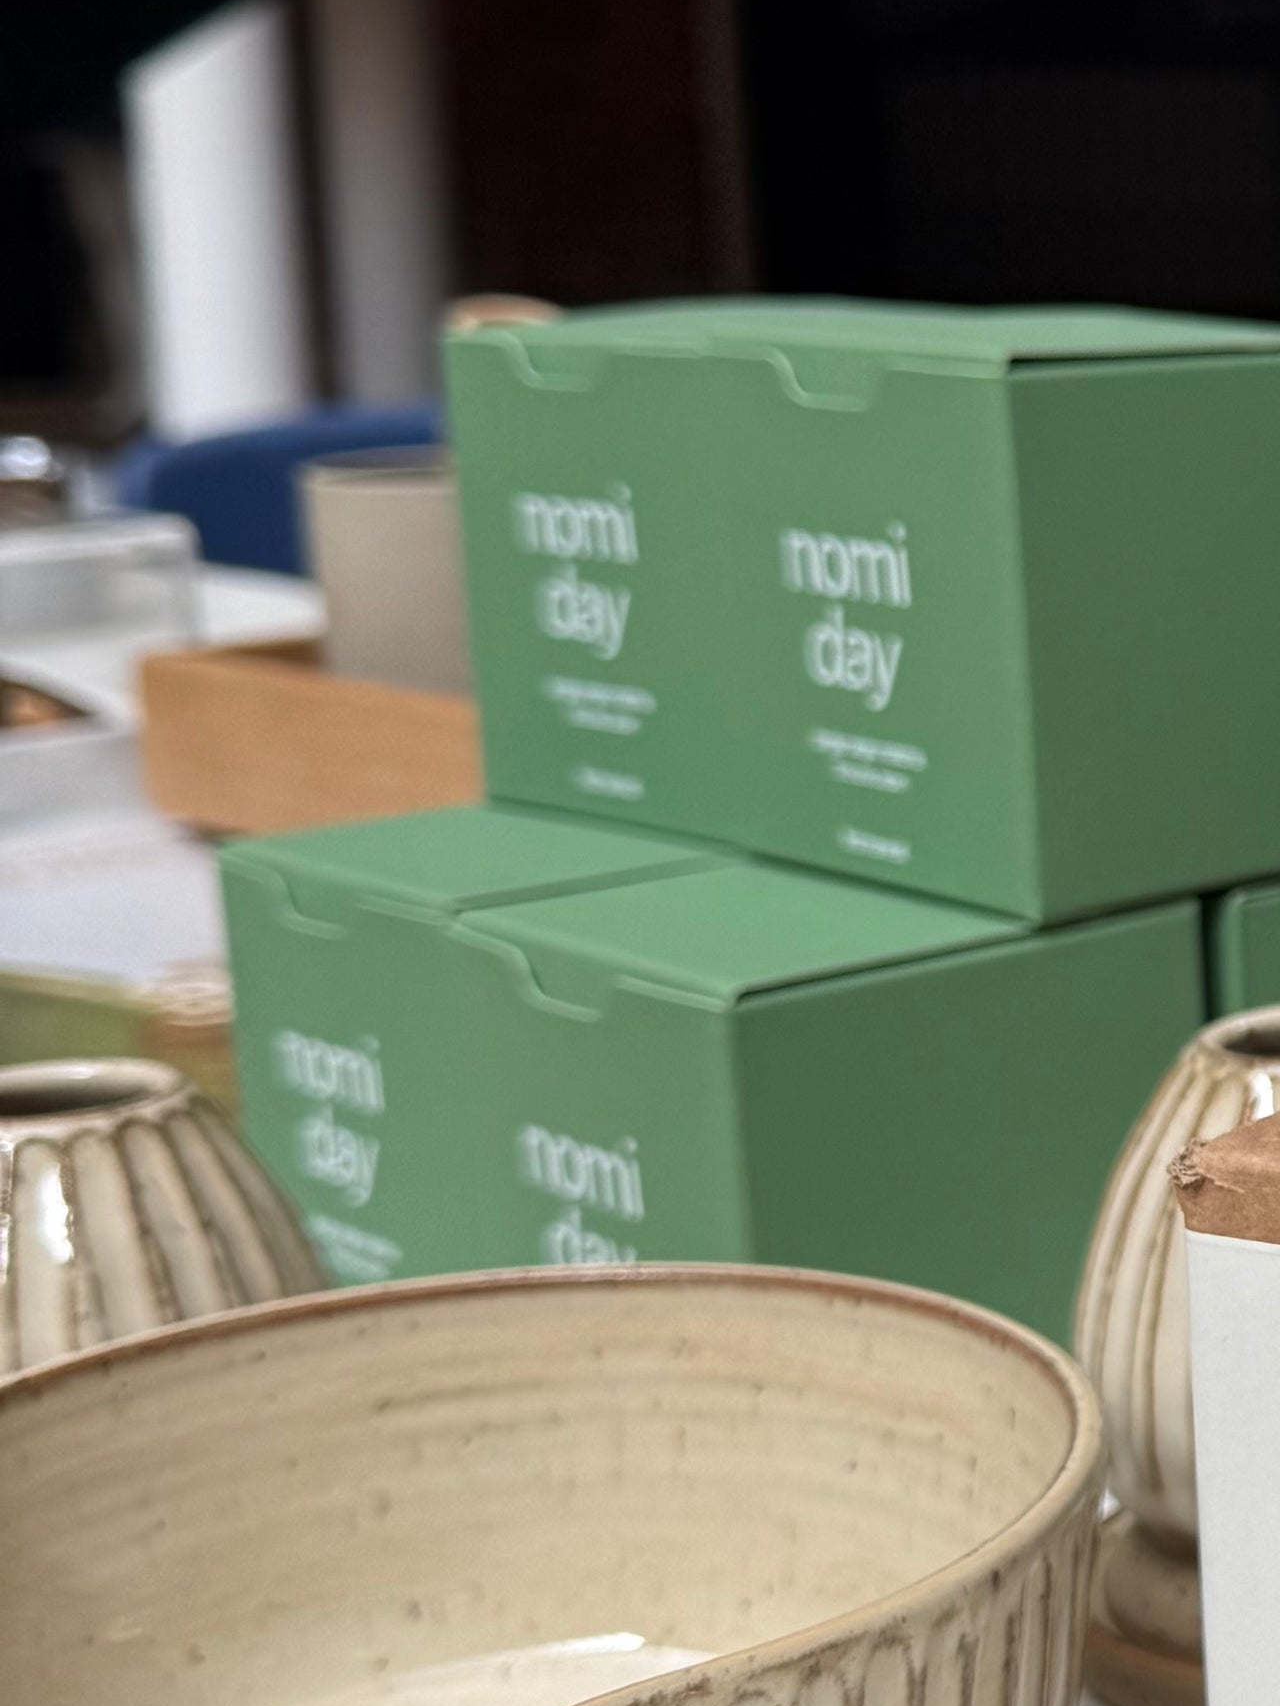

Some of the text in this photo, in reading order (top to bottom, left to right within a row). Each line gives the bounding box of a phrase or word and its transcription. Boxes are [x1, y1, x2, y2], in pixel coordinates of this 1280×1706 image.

[513, 482, 639, 565] nomi
[780, 522, 912, 609] nomi
[540, 561, 631, 661] day
[806, 603, 901, 711] day
[519, 1123, 644, 1222] nomi
